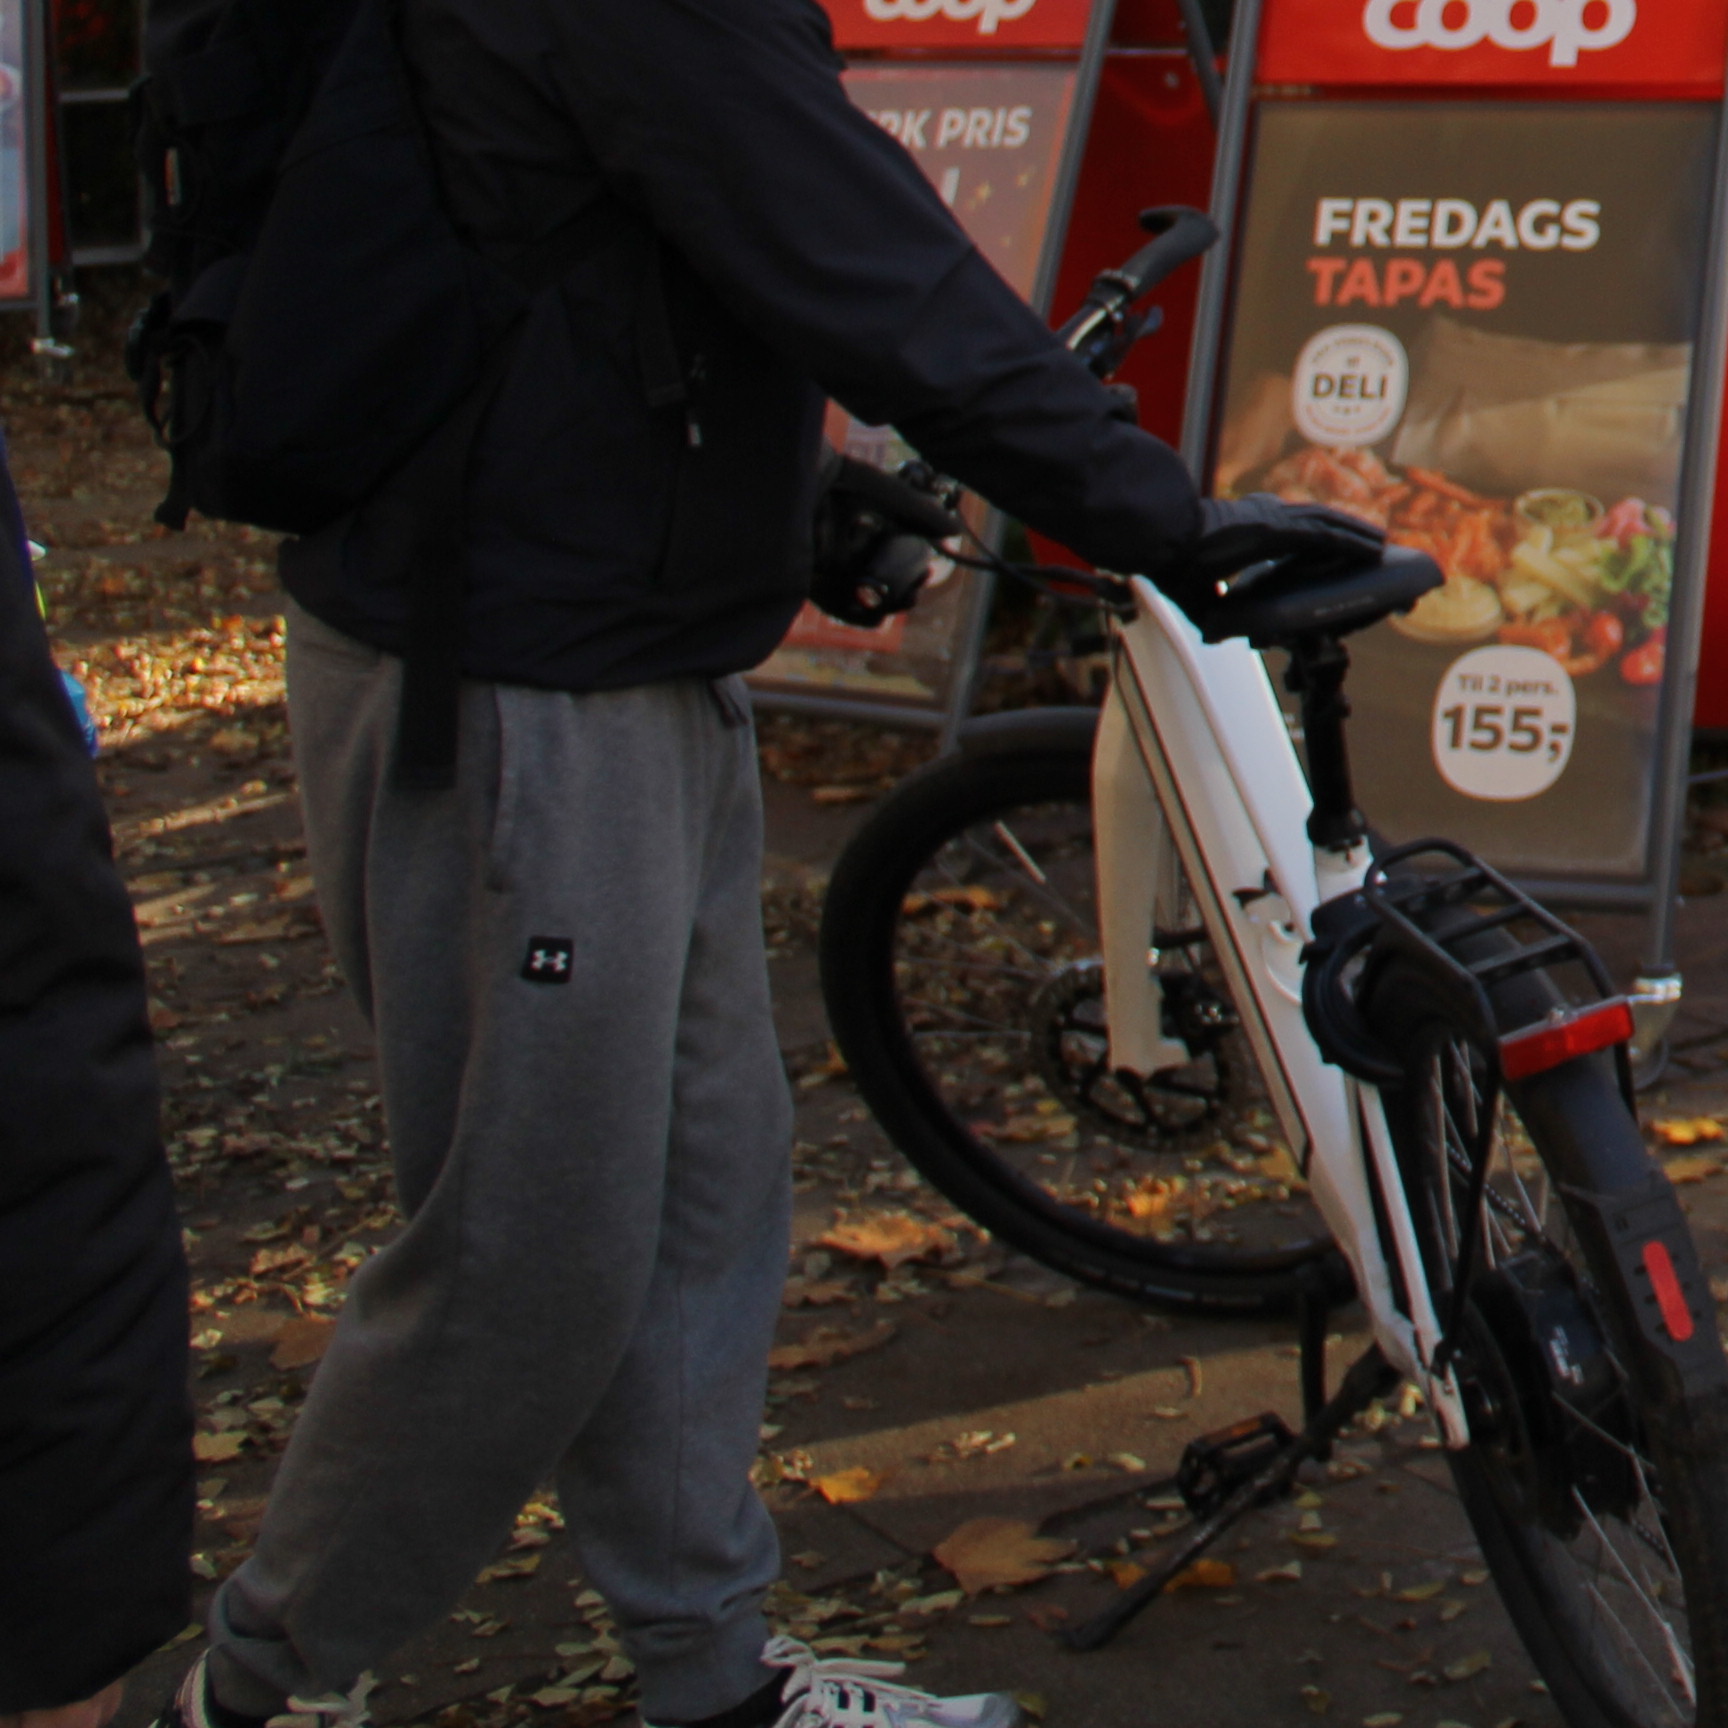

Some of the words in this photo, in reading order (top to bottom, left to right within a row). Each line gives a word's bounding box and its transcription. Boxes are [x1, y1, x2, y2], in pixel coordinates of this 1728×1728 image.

[935, 105, 1034, 149] PRIS
[1313, 197, 1602, 251] FREDAGS
[1306, 257, 1508, 310] TAPAS
[1312, 372, 1390, 400] DELI
[1457, 675, 1484, 694] Til
[1488, 676, 1501, 695] 2
[1504, 680, 1559, 699] pers.
